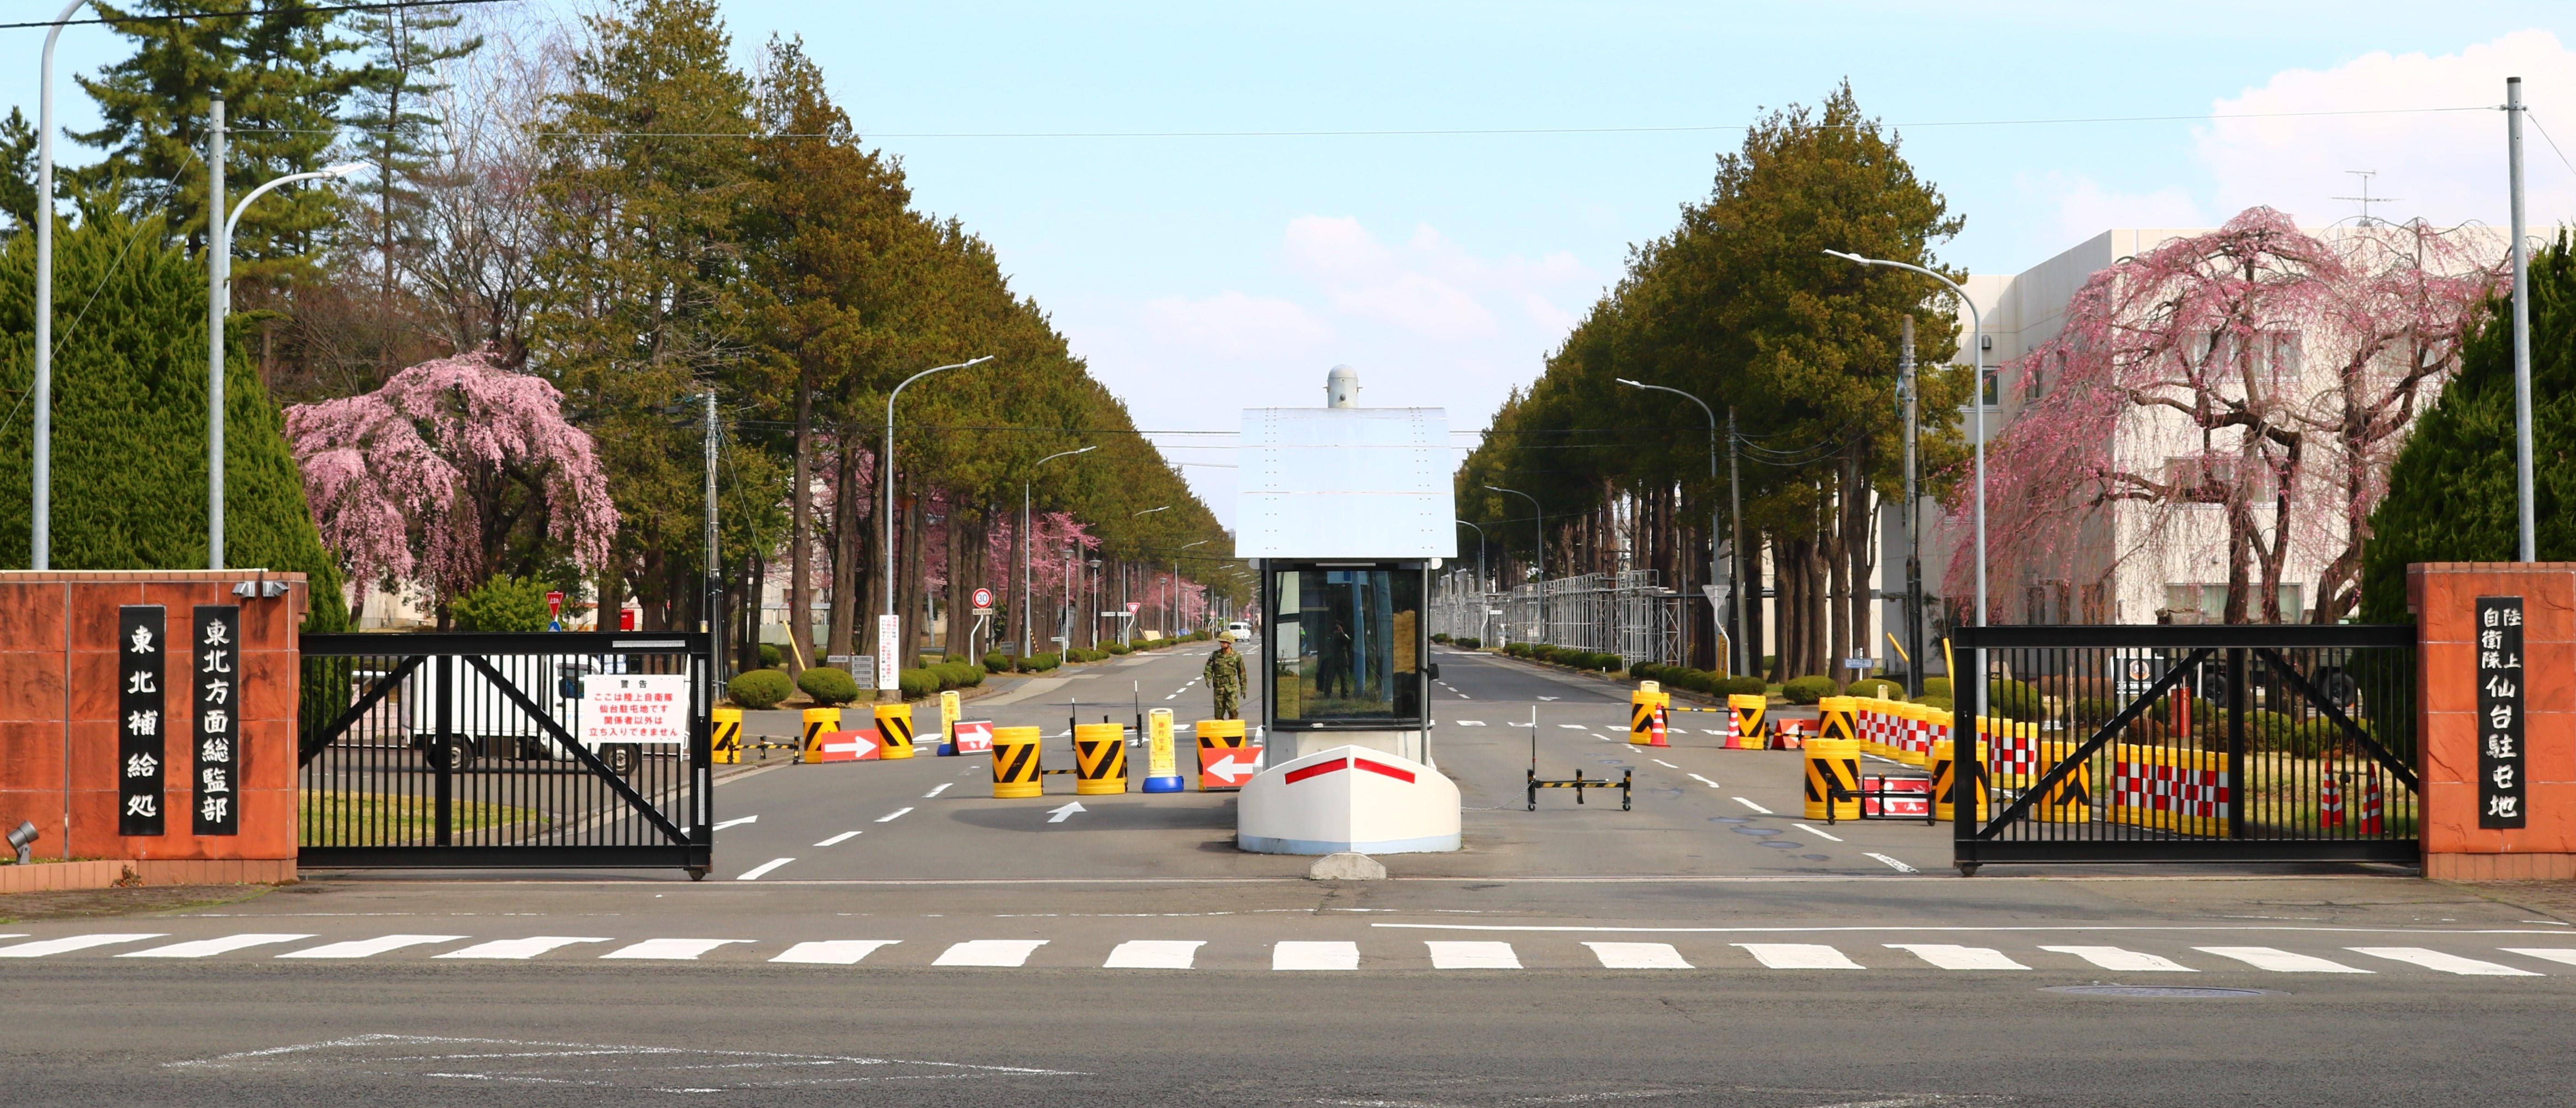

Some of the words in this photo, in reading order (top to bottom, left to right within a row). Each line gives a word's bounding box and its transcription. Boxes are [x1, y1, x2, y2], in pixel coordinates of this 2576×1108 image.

[977, 594, 987, 603] 30
[2481, 608, 2502, 669] 自衛隊
[621, 680, 647, 688] 警告
[595, 693, 673, 701] ここは陸上自衛隊
[600, 705, 668, 713] 仙台駐屯地です
[127, 625, 158, 817] 東北補給処
[201, 619, 230, 823] 東北方面総監部
[604, 716, 662, 724] 関係者以外は
[589, 728, 678, 736] 立ち入りできません
[2485, 675, 2517, 818] 仙台駐屯地
